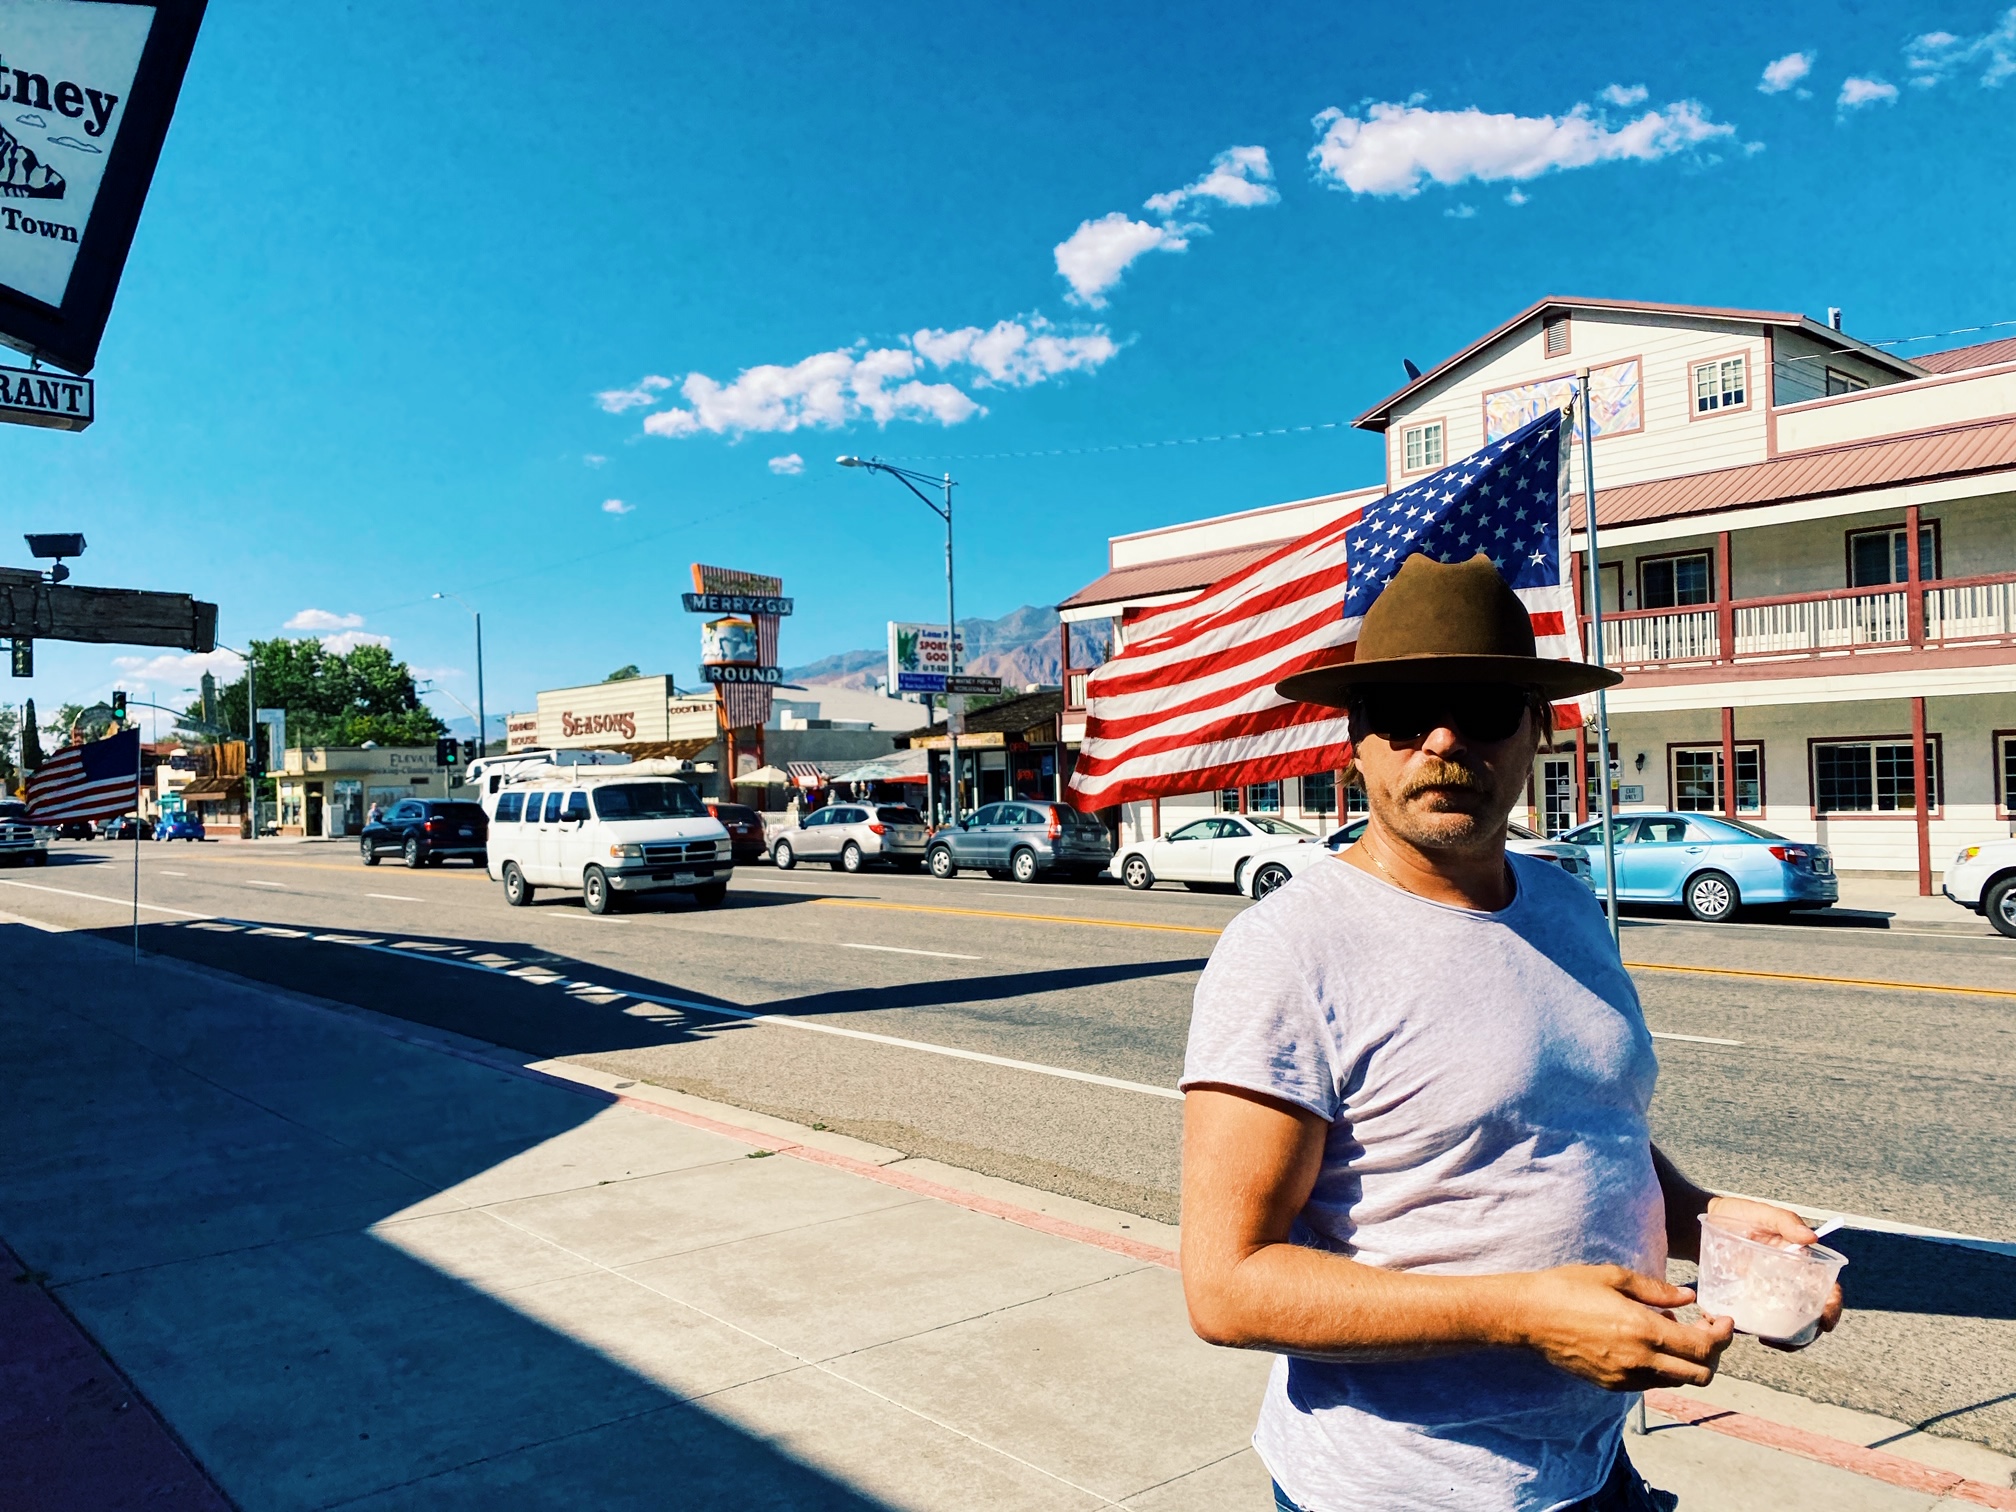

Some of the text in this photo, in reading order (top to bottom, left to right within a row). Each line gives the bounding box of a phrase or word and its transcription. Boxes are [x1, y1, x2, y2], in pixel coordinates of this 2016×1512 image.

[2, 207, 78, 243] Town
[0, 374, 83, 412] RANT
[926, 652, 958, 662] GOOS
[711, 667, 778, 682] ROUND
[670, 704, 714, 714] COCKAILS
[562, 711, 637, 739] SEASONS
[390, 753, 437, 766] ELEVATIO
